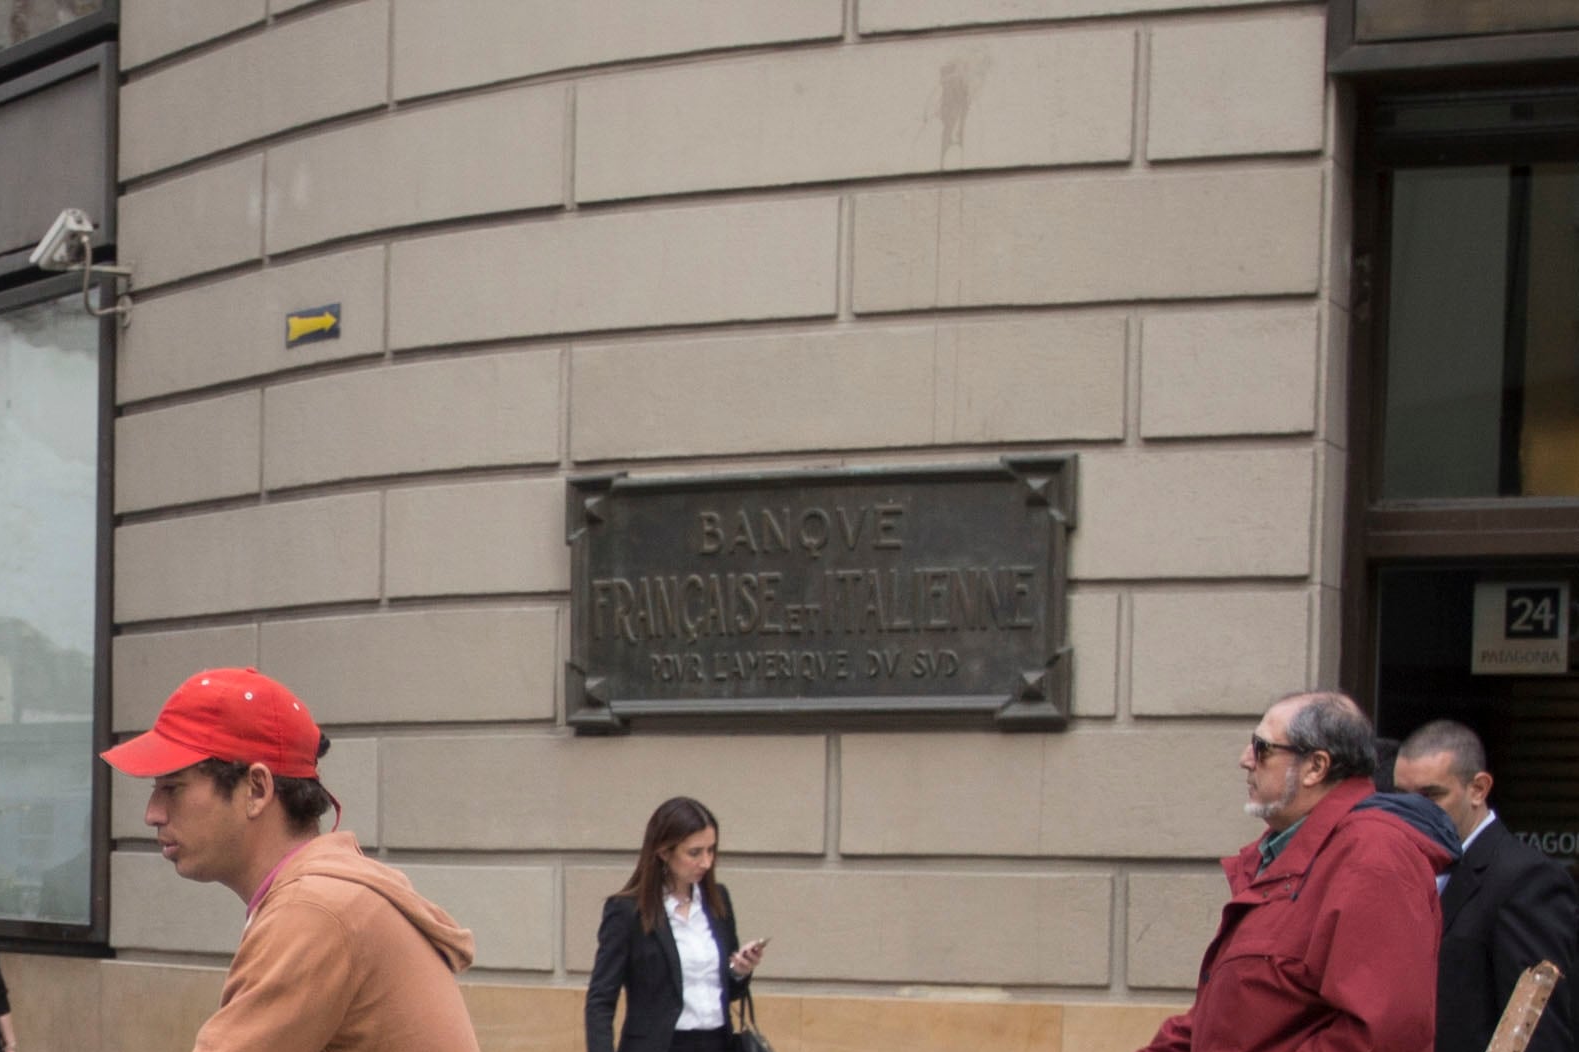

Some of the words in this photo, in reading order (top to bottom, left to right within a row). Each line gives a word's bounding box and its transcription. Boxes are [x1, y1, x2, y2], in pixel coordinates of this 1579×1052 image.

[591, 572, 783, 645] FRANÇAISE
[824, 565, 1036, 634] ITALIENNE
[1510, 596, 1556, 632] 24
